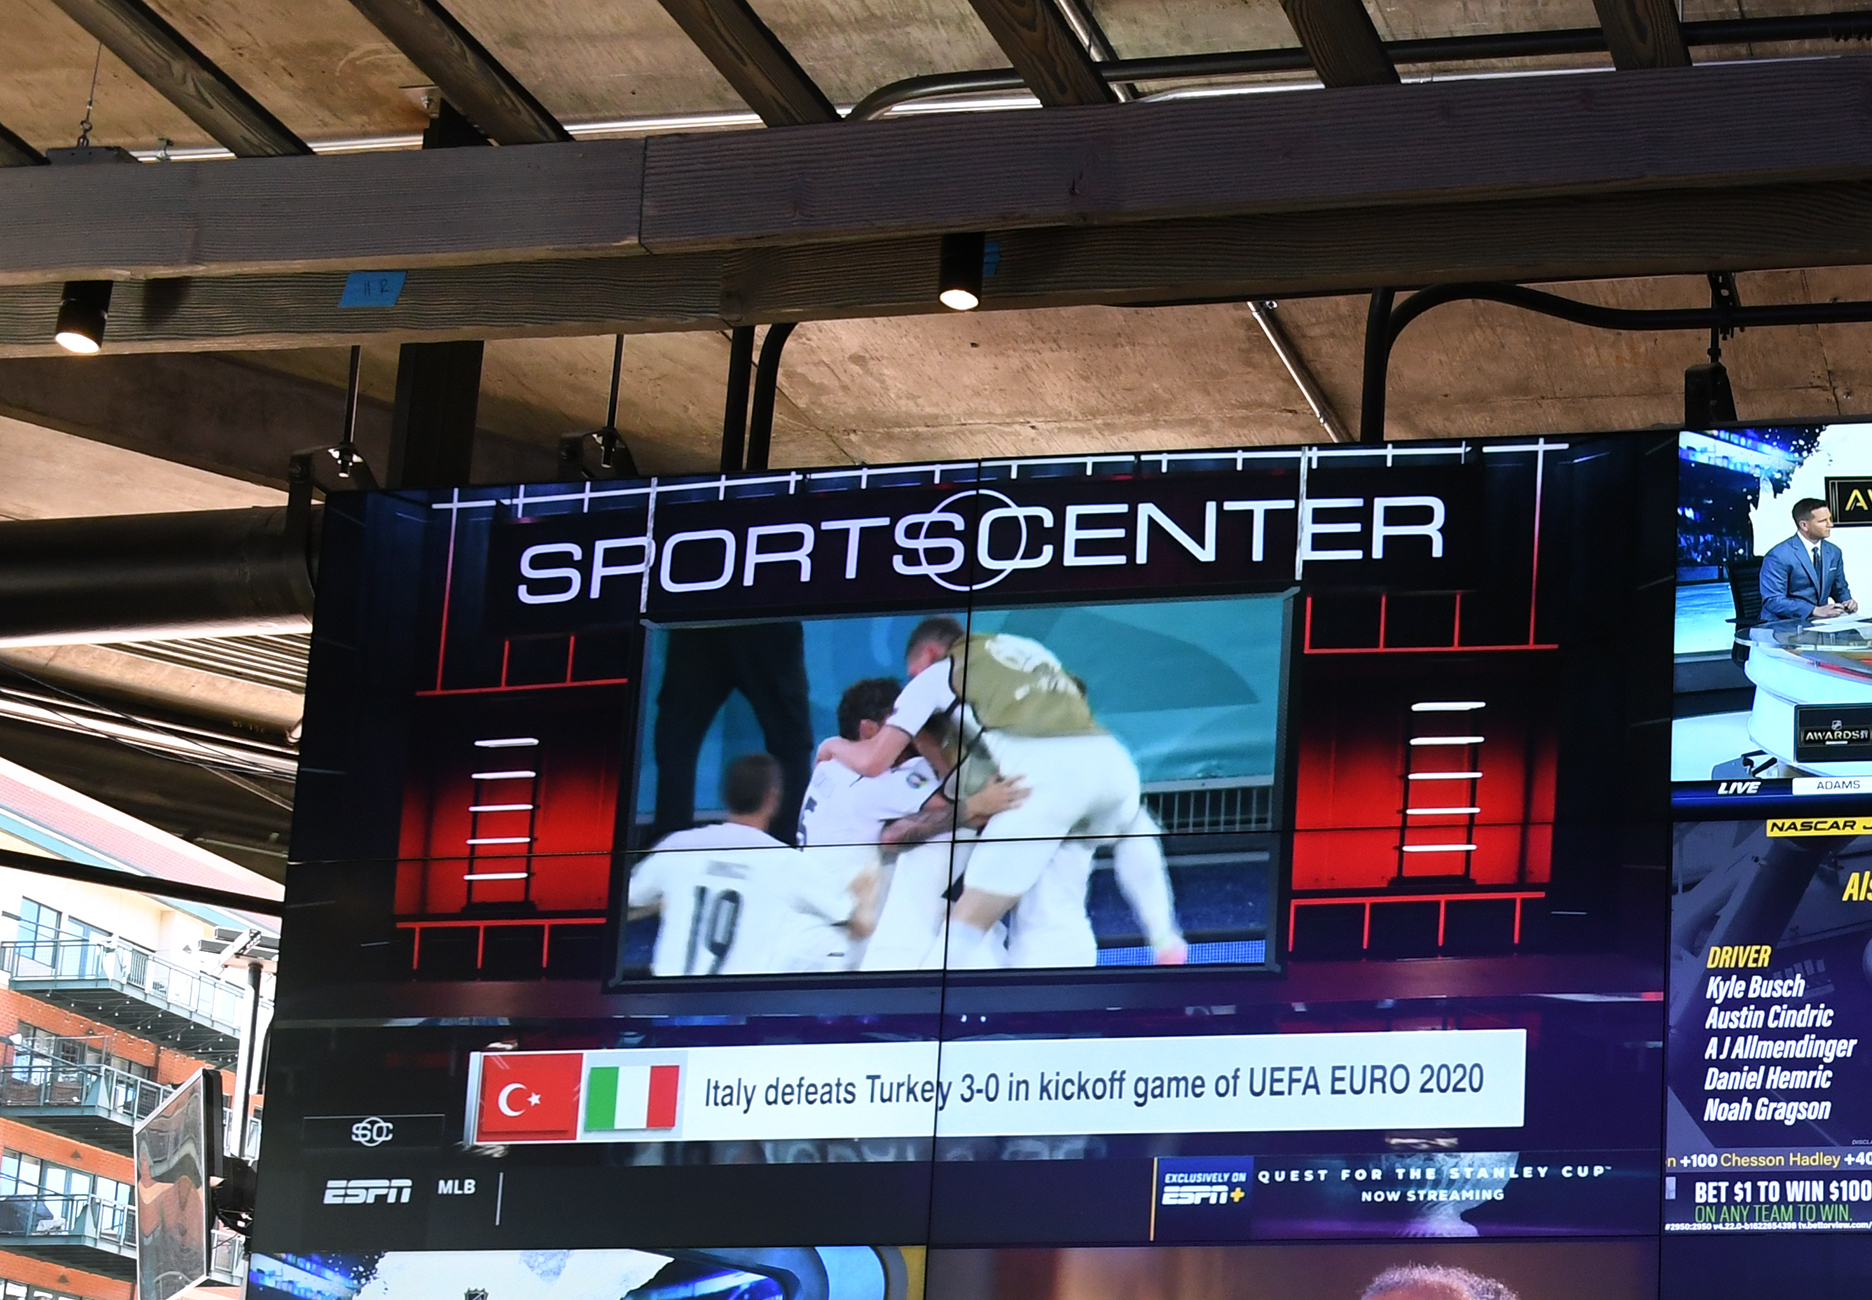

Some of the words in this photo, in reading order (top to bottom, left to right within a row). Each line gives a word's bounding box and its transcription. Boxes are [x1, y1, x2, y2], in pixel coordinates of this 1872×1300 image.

[516, 494, 1446, 605] SPORTSCENTER
[1717, 781, 1762, 795] LIVE
[1816, 779, 1861, 790] ADAMS
[1770, 819, 1856, 833] NASCAR
[1706, 945, 1772, 968] DRIVER
[1706, 976, 1744, 1004] Kyle
[1748, 974, 1805, 998] Busch
[1705, 1005, 1765, 1029] Austin
[1767, 1004, 1834, 1028] Cindric
[1705, 1037, 1717, 1059] A
[1719, 1036, 1730, 1059] J
[1731, 1034, 1857, 1063] Allmendinger
[705, 1077, 756, 1114] Italy
[765, 1076, 856, 1105] defeats
[866, 1074, 952, 1111] Turkey
[960, 1072, 1000, 1102] 3-0
[1008, 1072, 1030, 1101] in
[1039, 1070, 1126, 1101] kickoff
[1133, 1074, 1205, 1107] game
[1215, 1068, 1240, 1097] of
[1249, 1065, 1321, 1096] UEFA
[1330, 1064, 1411, 1095] EURO
[1420, 1062, 1484, 1093] 2020
[1704, 1066, 1764, 1090] Daniel
[1766, 1065, 1833, 1089] Hemric
[1704, 1097, 1752, 1121] Noah
[1755, 1098, 1831, 1126] Gragson
[1679, 1153, 1718, 1168] +100
[1720, 1152, 1785, 1168] Chesson
[1789, 1152, 1841, 1169] Hadley
[1164, 1172, 1229, 1184] EXCLUSIVELY
[1232, 1172, 1246, 1182] ON
[1258, 1169, 1328, 1183] QUEST
[1341, 1168, 1383, 1181] FOR
[1397, 1167, 1436, 1180] THE
[1450, 1166, 1549, 1179] STANLEY
[323, 1179, 412, 1204] ESPN
[437, 1179, 476, 1195] MLB
[1361, 1191, 1400, 1202] NOW
[1407, 1189, 1505, 1202] STREAMING
[1695, 1181, 1729, 1203] BET
[1734, 1180, 1752, 1203] $1
[1757, 1180, 1780, 1202] TO
[1786, 1180, 1824, 1202] WIN
[1829, 1179, 1872, 1202] $100
